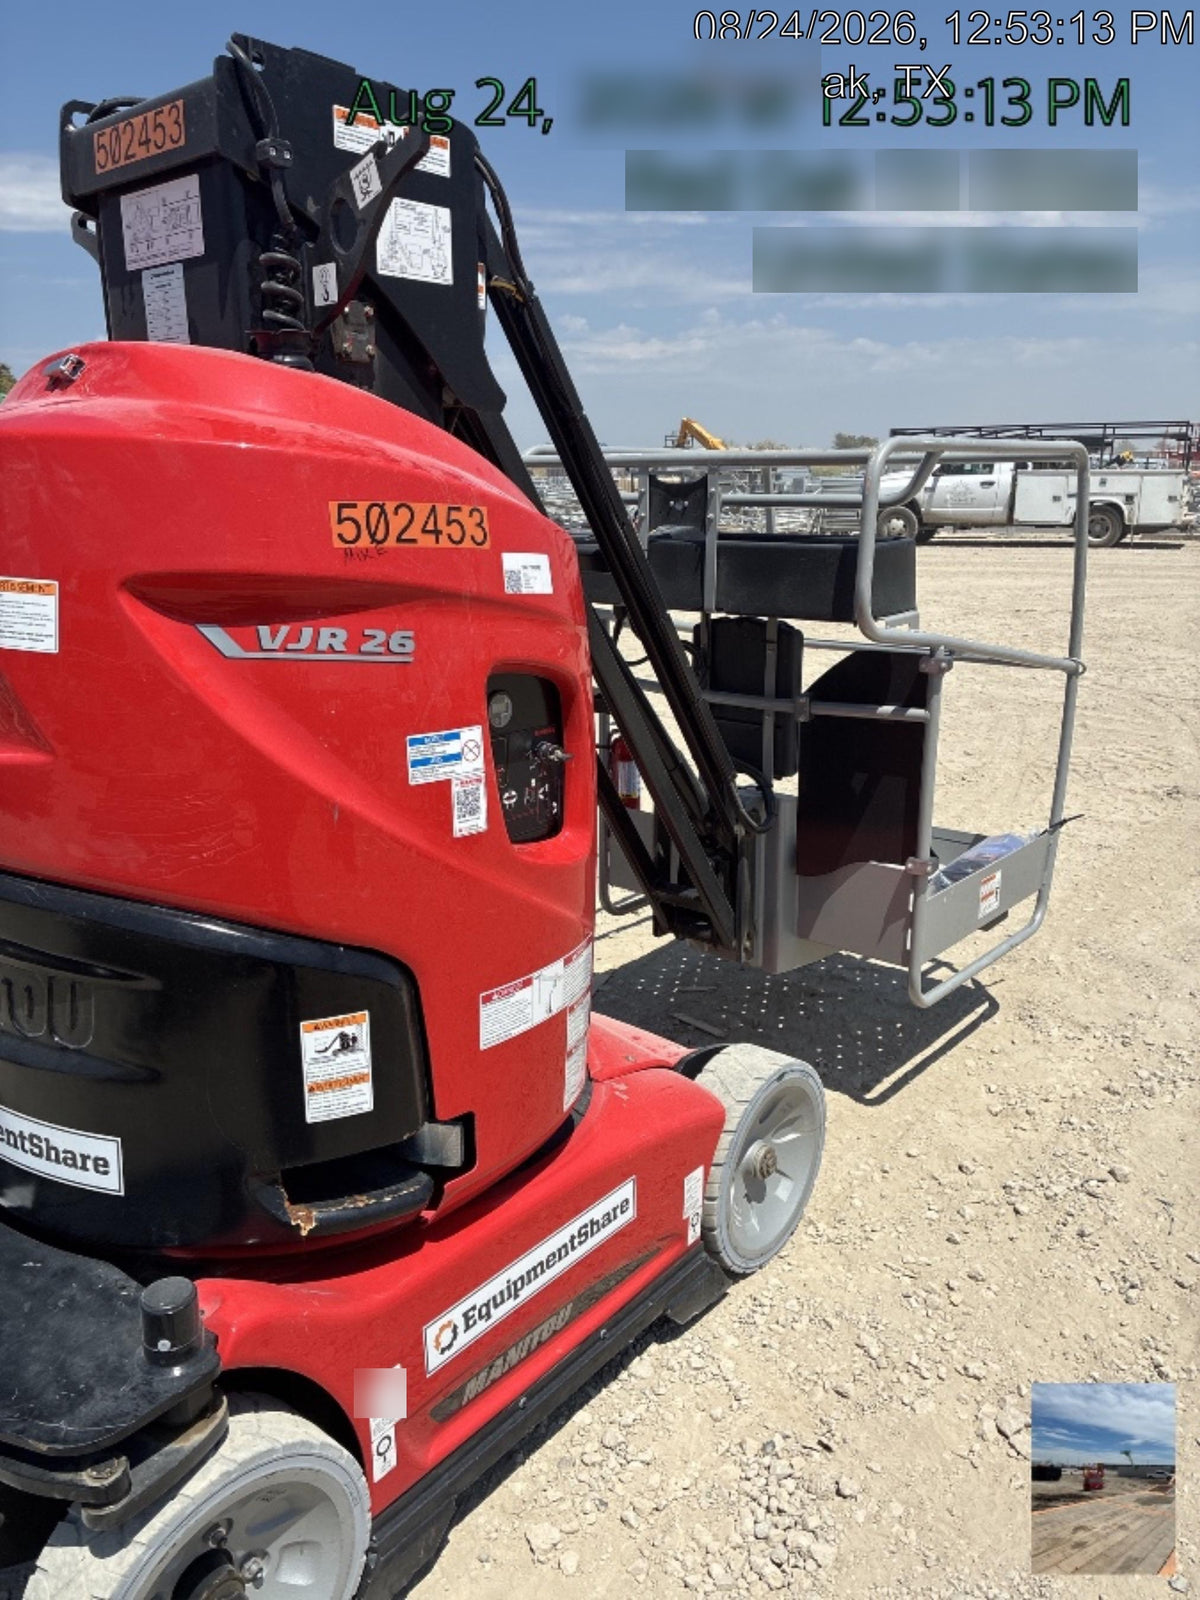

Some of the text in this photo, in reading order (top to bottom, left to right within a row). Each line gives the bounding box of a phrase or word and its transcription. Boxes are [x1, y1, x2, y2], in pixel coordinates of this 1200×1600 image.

[96, 103, 182, 169] 502453
[336, 502, 488, 546] 502453
[256, 624, 416, 654] VJR 26
[461, 1195, 630, 1334] EquipmentShare
